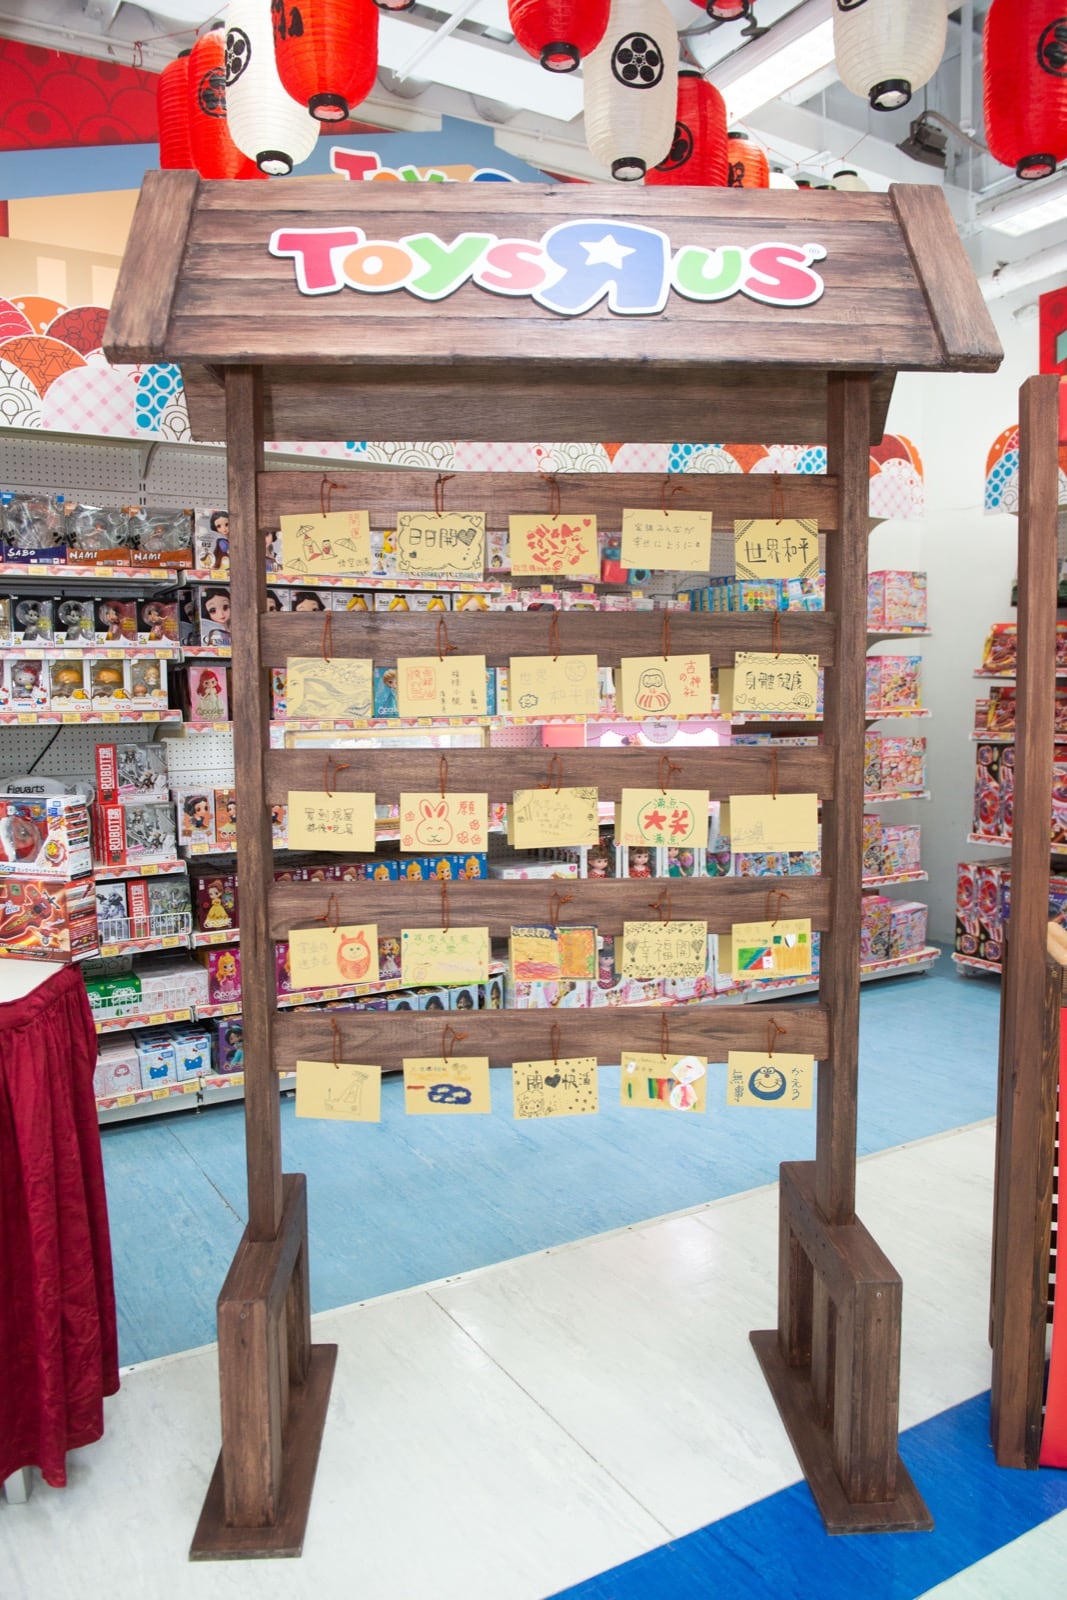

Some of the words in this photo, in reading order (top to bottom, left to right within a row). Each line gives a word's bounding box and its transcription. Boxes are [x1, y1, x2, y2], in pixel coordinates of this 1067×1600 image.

[7, 549, 36, 557] SABO
[744, 537, 809, 564] 世界和平
[69, 552, 98, 560] NAMI
[134, 553, 161, 561] NAMI
[7, 784, 45, 794] Figuarts
